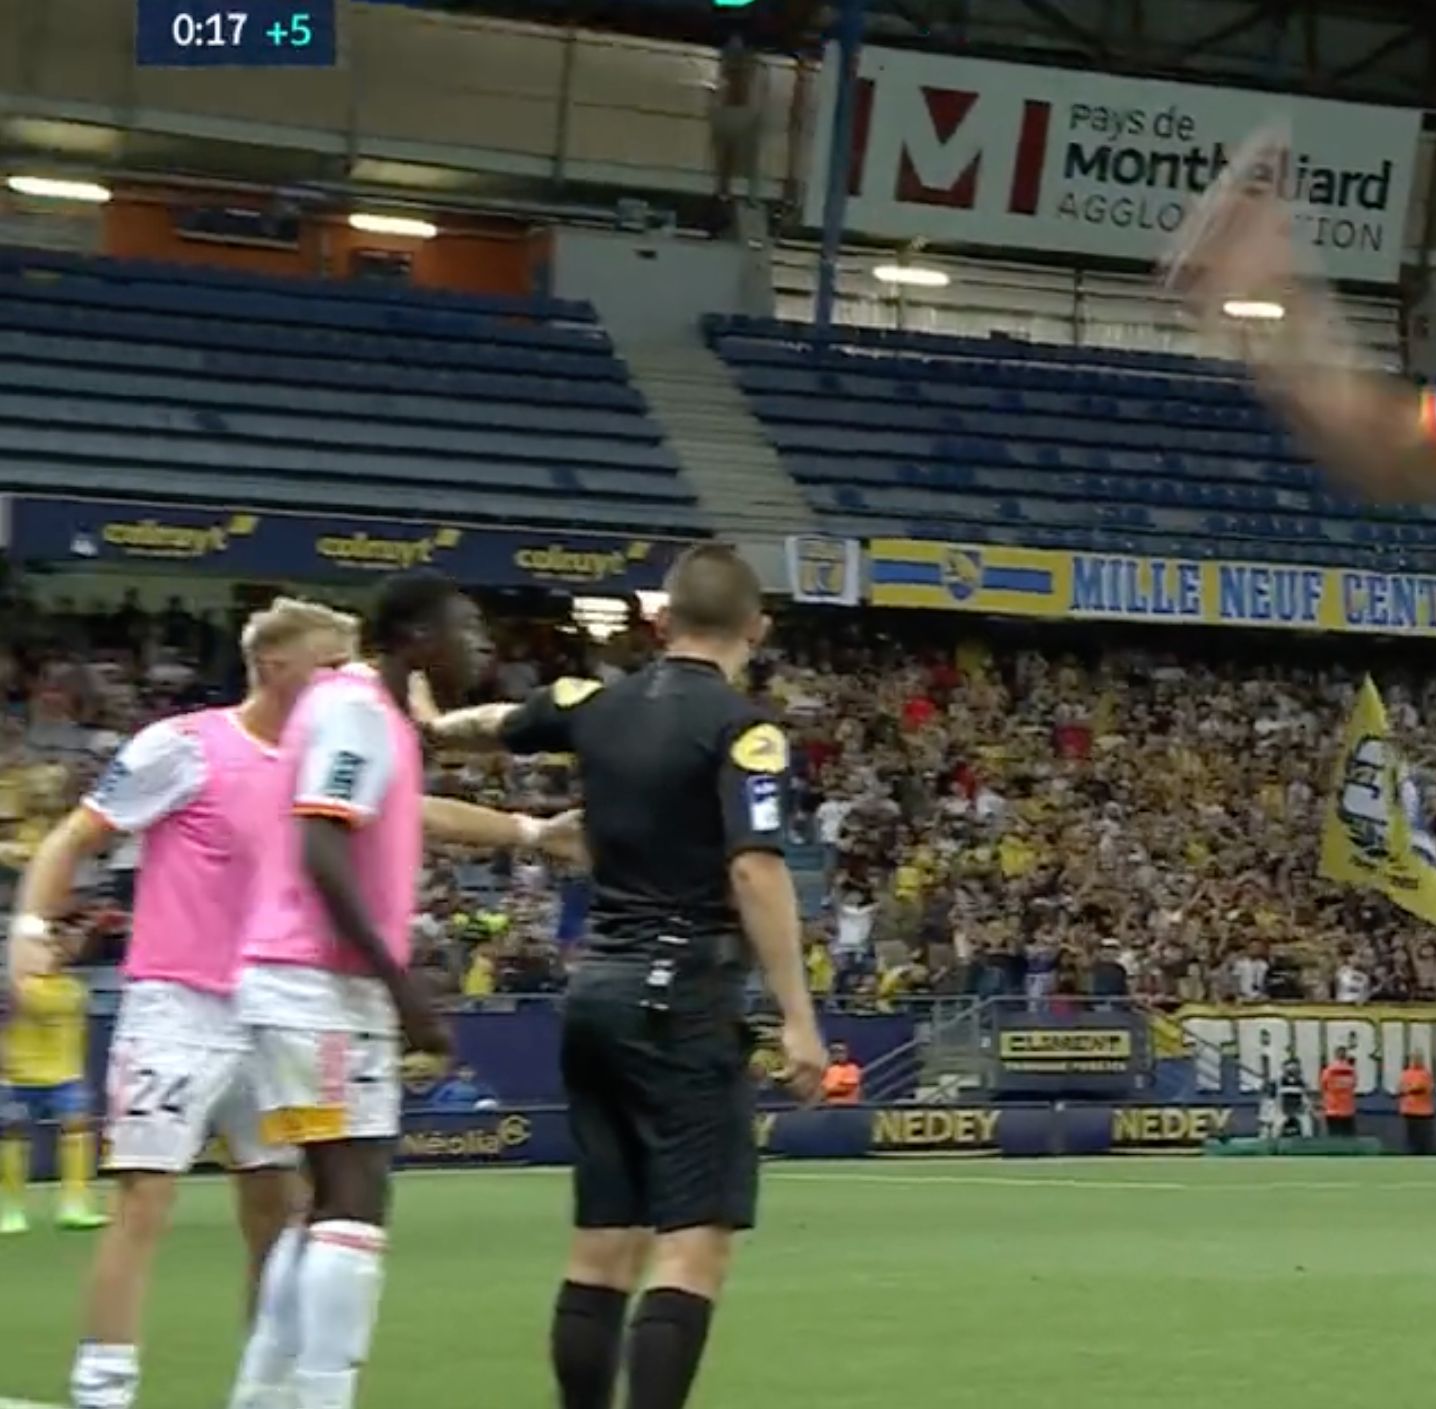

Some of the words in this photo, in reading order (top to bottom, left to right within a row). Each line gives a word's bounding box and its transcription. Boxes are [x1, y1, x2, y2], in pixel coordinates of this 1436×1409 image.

[1069, 103, 1146, 142] Pays
[1152, 105, 1196, 142] de
[1069, 555, 1201, 615] MILLE
[1218, 565, 1323, 622] NEUF
[873, 1110, 1001, 1143] NEDEY
[1113, 1109, 1233, 1143] NEDEY
